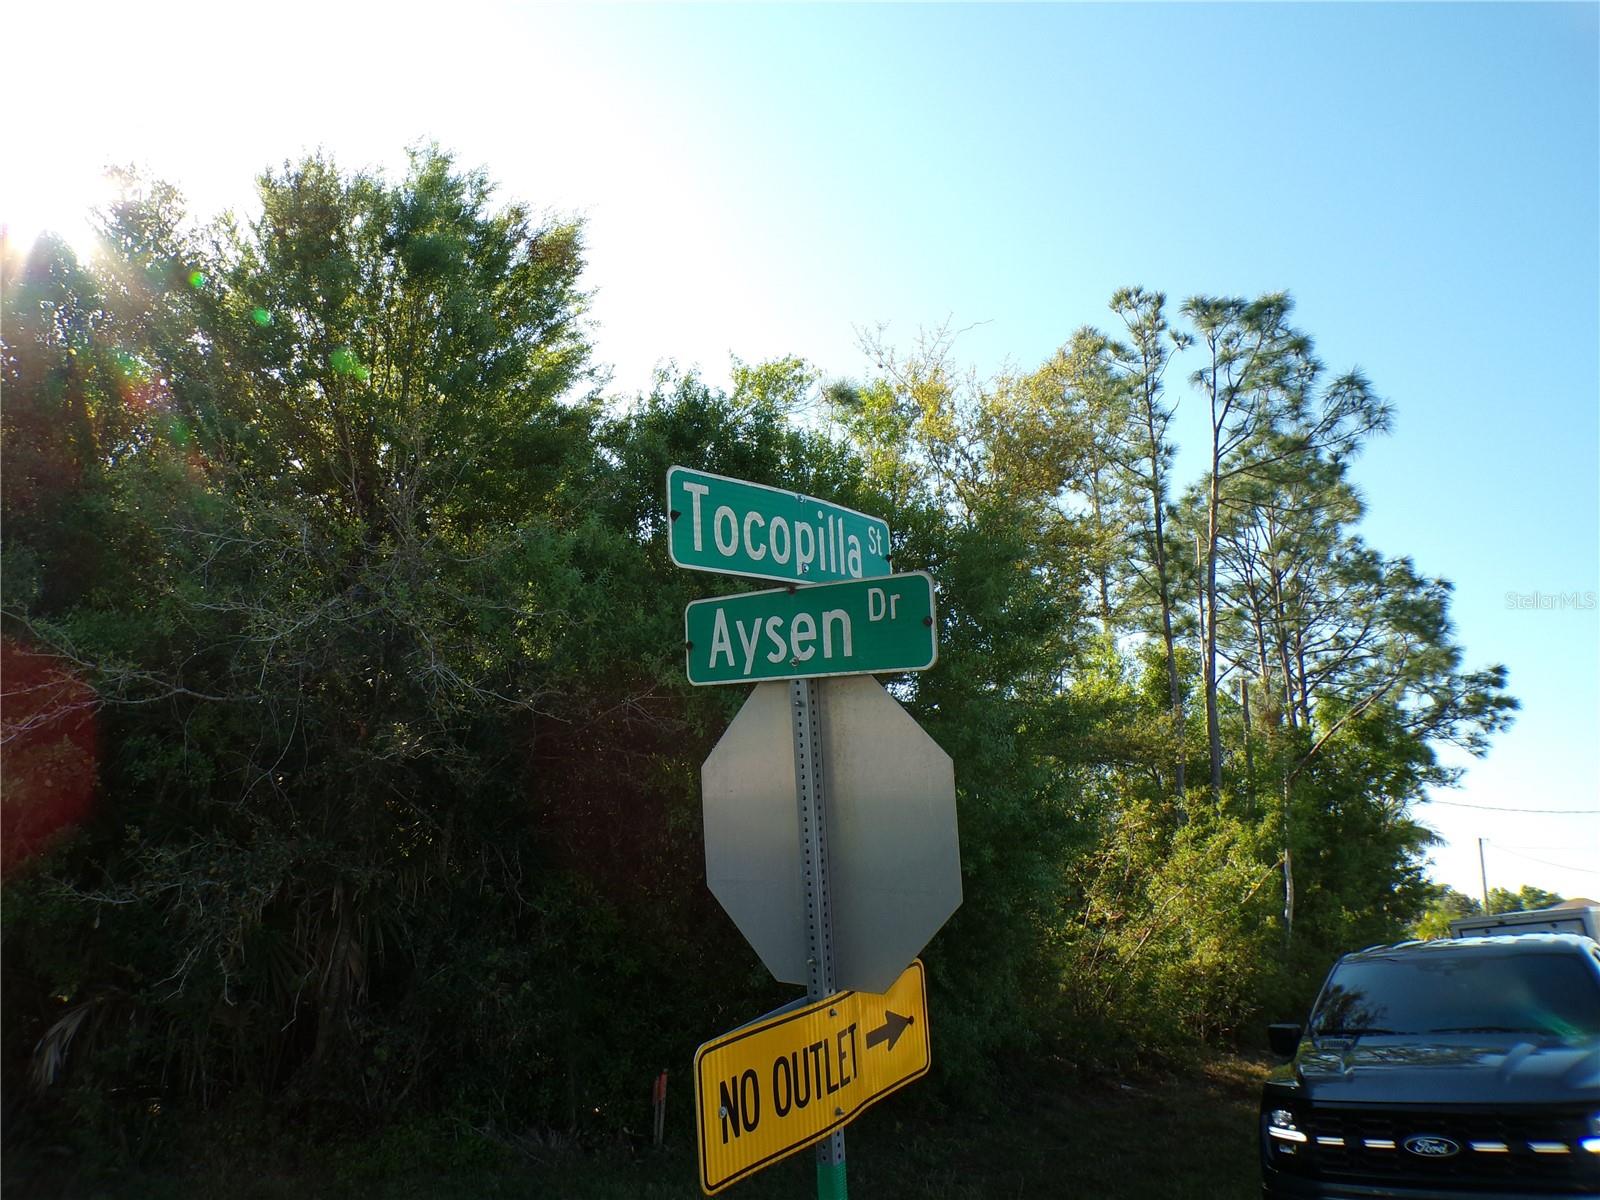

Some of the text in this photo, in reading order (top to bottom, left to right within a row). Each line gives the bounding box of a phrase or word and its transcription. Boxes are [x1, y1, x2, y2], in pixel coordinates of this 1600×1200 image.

[683, 481, 882, 579] Tocopilla St
[709, 588, 900, 675] Aysen Dr
[719, 1022, 858, 1144] NO OUTLET
[1415, 1139, 1449, 1154] Ford
